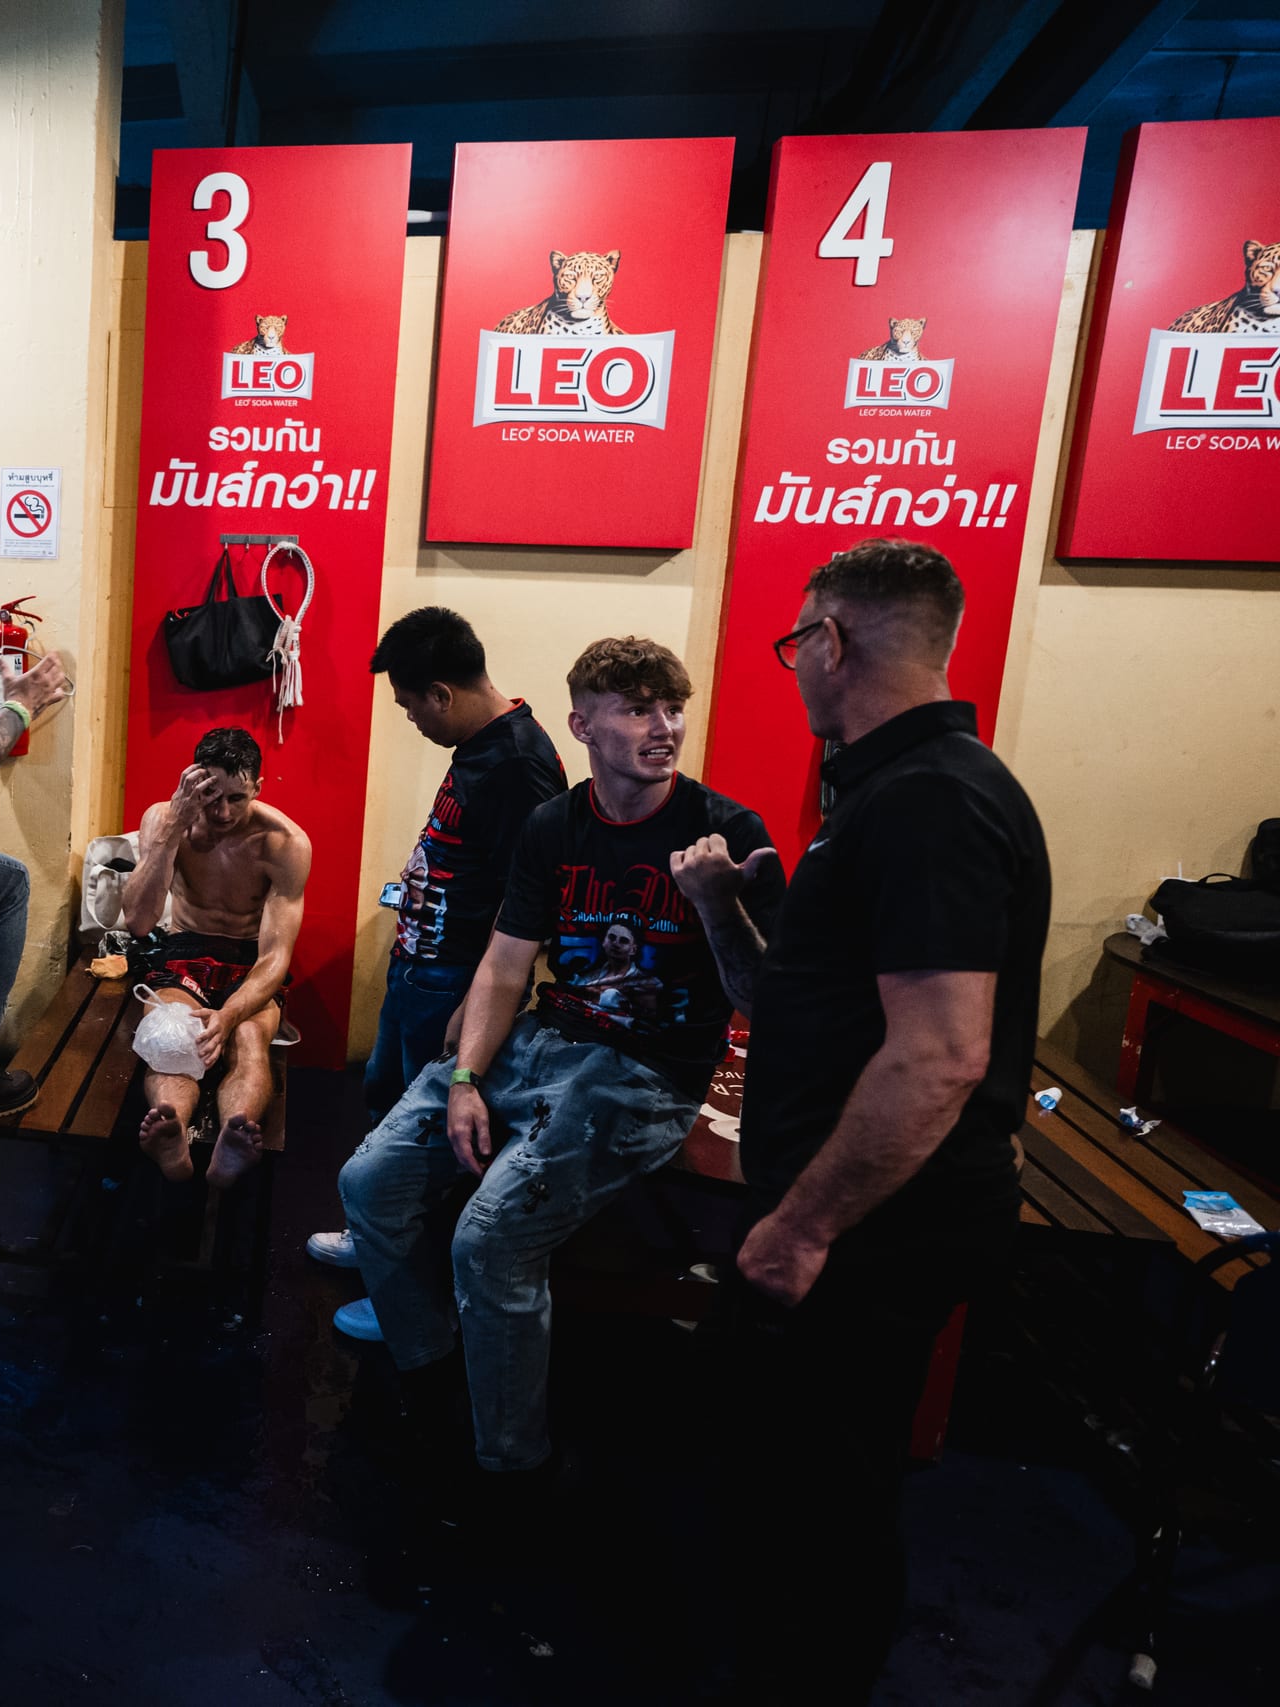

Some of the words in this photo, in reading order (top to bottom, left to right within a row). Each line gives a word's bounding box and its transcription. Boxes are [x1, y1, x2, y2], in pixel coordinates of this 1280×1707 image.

[189, 172, 250, 289] 3
[818, 161, 894, 286] 4
[232, 360, 303, 390] LEO
[494, 346, 649, 408] LEO
[857, 366, 942, 400] LEO
[1160, 346, 1280, 411] LE
[252, 399, 273, 407] SODA
[273, 399, 298, 407] WATER
[878, 408, 902, 417] SODA
[903, 408, 932, 417] WATER
[208, 418, 321, 452] รวมกัน
[537, 428, 581, 442] SODA
[583, 429, 635, 443] WATER
[825, 429, 956, 466] รวมกัน
[1208, 435, 1261, 450] SODA
[149, 458, 377, 510] มันส์กว่า!!
[753, 471, 1018, 528] มันส์กว่า!!
